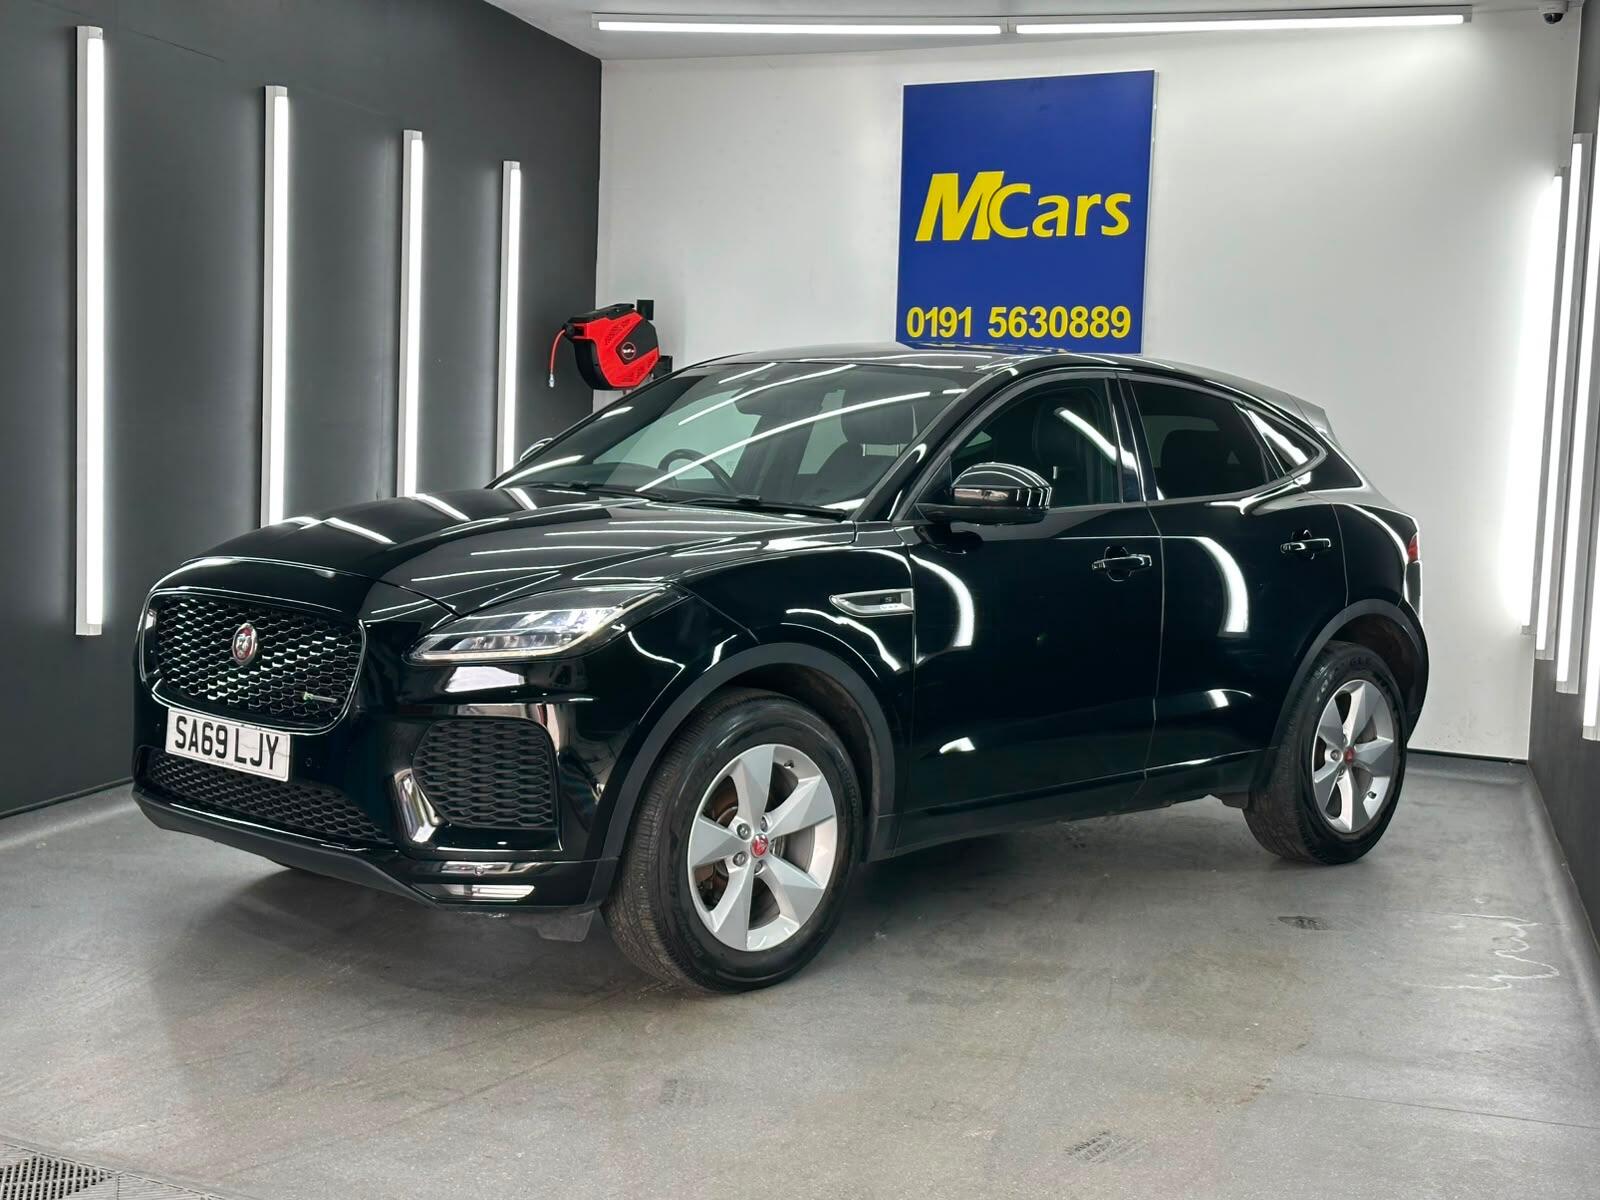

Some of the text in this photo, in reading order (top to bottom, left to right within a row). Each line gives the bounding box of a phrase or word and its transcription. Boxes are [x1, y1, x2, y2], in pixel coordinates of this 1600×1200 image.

[915, 171, 1131, 242] MCars
[906, 305, 1131, 338] 0191 5630889
[174, 715, 279, 770] SA69 LJY
